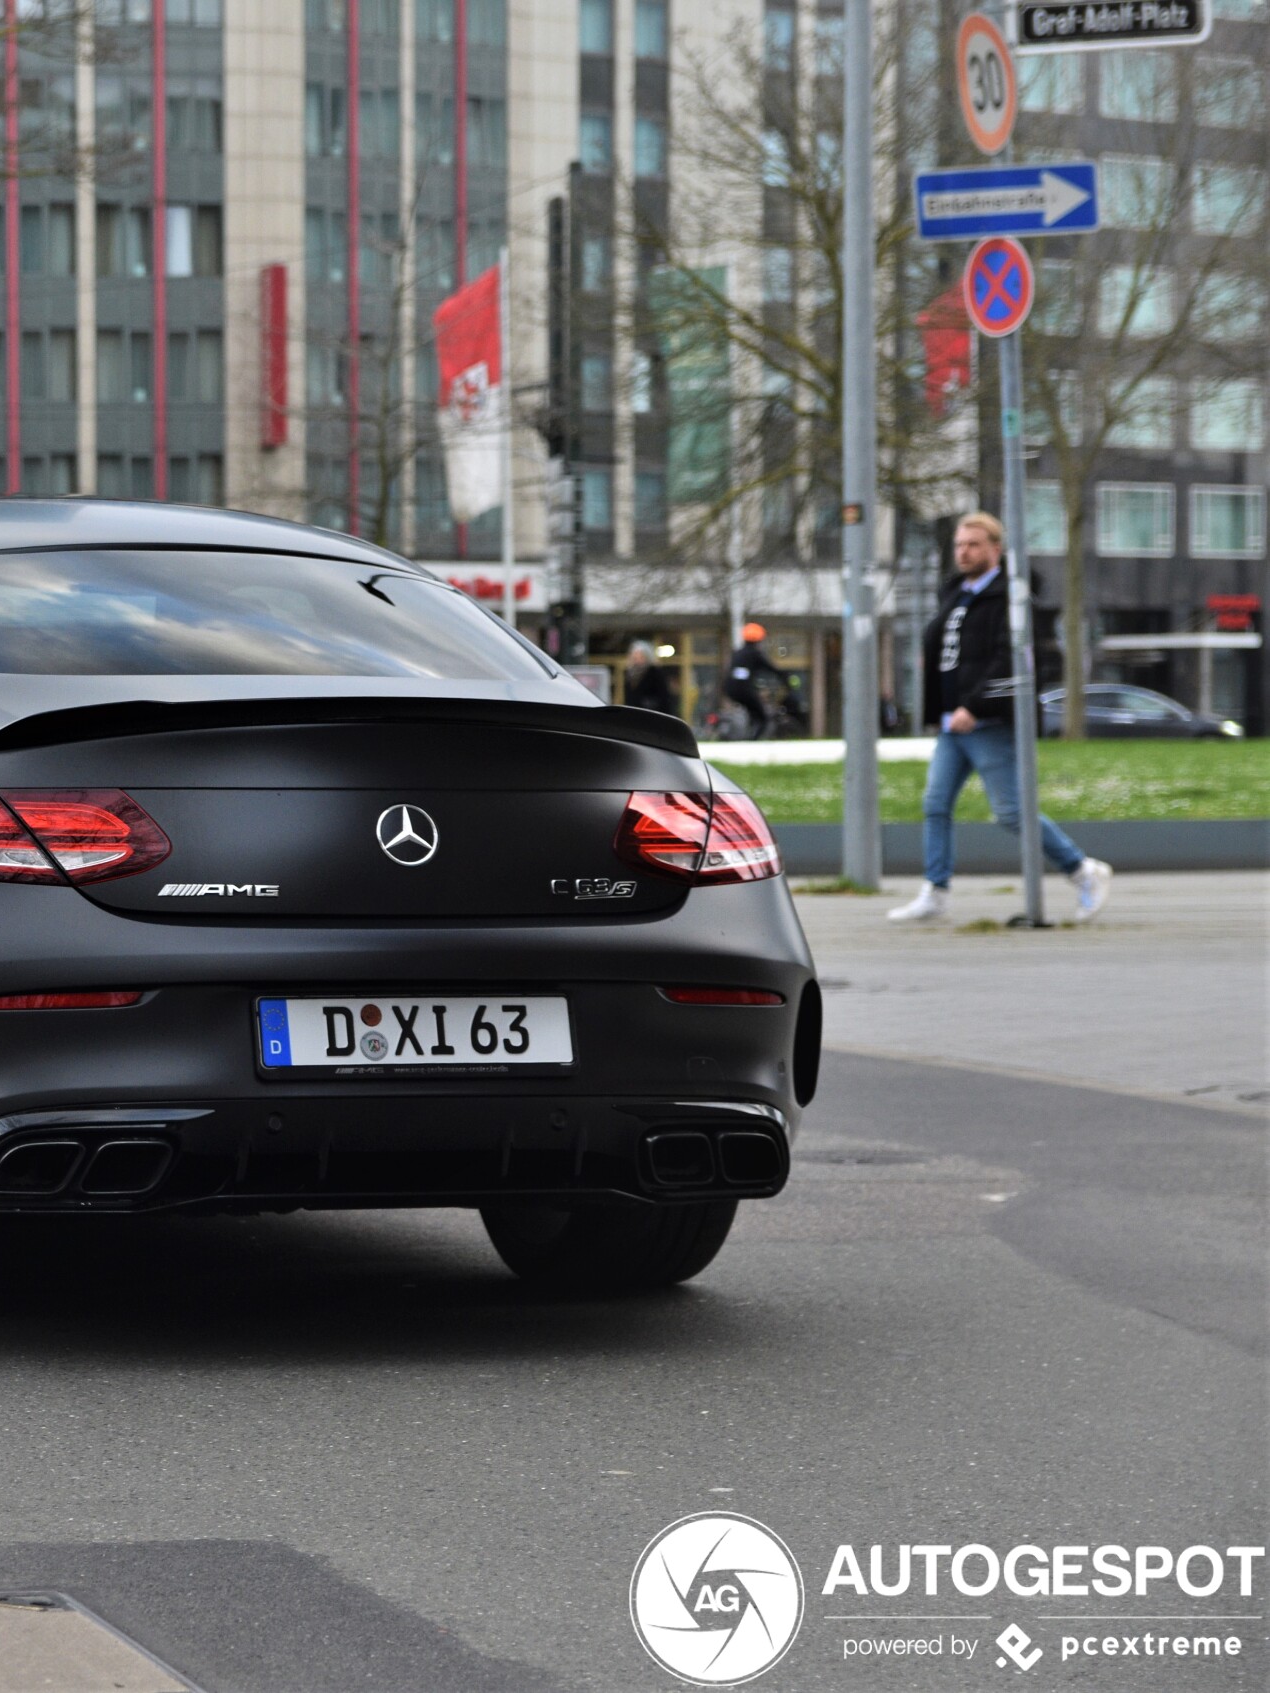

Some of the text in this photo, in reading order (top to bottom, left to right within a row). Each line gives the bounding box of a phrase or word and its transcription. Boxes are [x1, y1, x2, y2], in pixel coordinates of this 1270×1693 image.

[1033, 2, 1188, 36] Graf-Adolf-Platz
[969, 52, 1003, 113] 30
[197, 884, 280, 897] AMG
[270, 1040, 282, 1054] D
[323, 1004, 529, 1057] D XI 63
